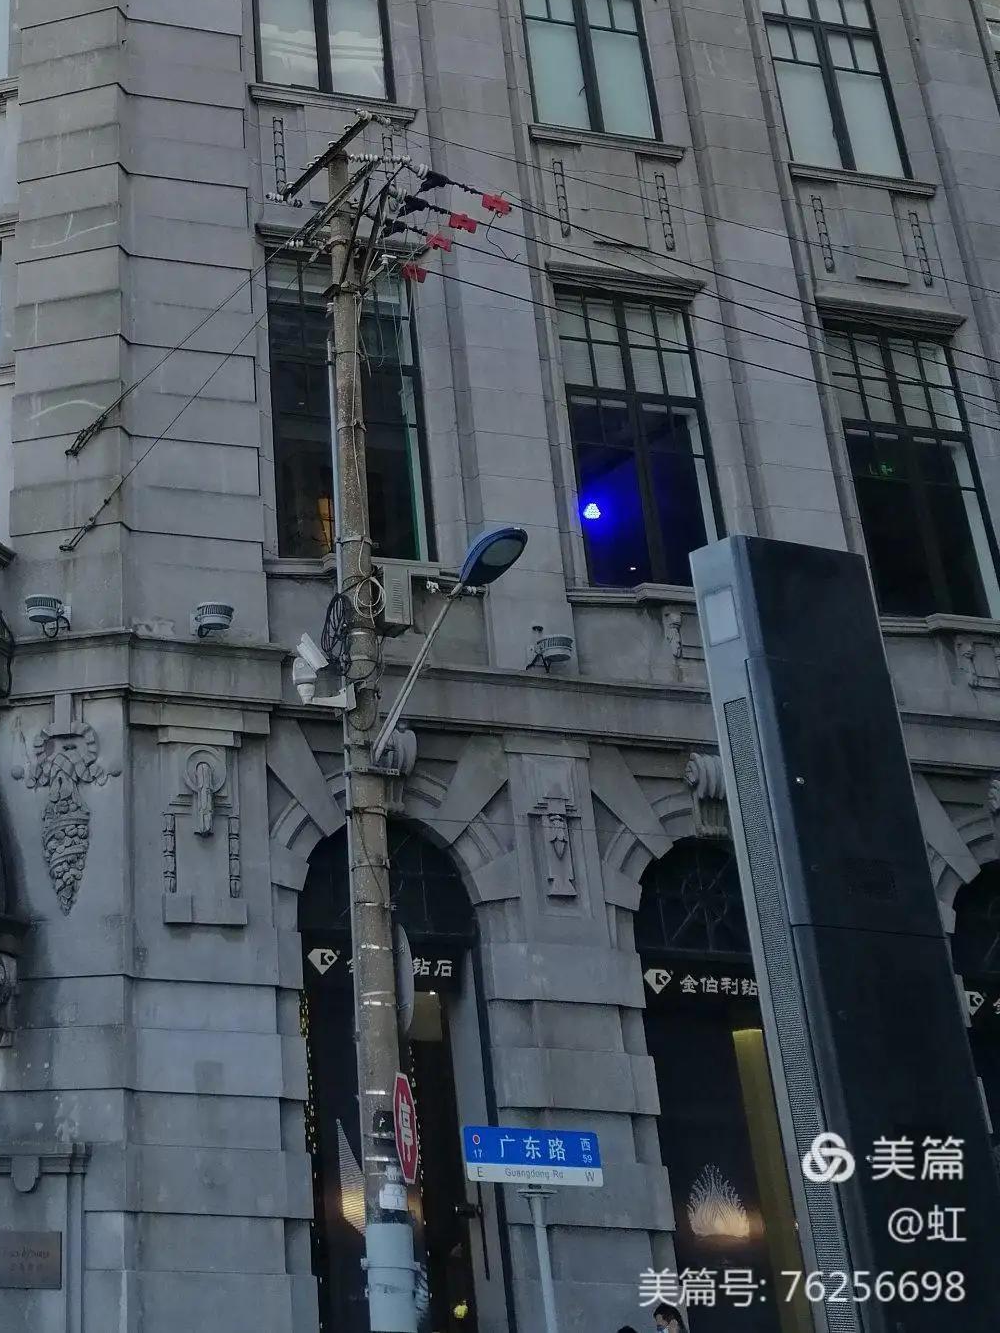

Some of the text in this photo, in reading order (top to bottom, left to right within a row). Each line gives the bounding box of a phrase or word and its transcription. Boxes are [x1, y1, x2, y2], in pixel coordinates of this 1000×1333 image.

[680, 974, 758, 996] 金伯利钻
[500, 1134, 567, 1162] 广东路
[580, 1137, 592, 1152] 西
[477, 1167, 485, 1178] E
[505, 1168, 550, 1180] Guangdong
[585, 1172, 595, 1182] W
